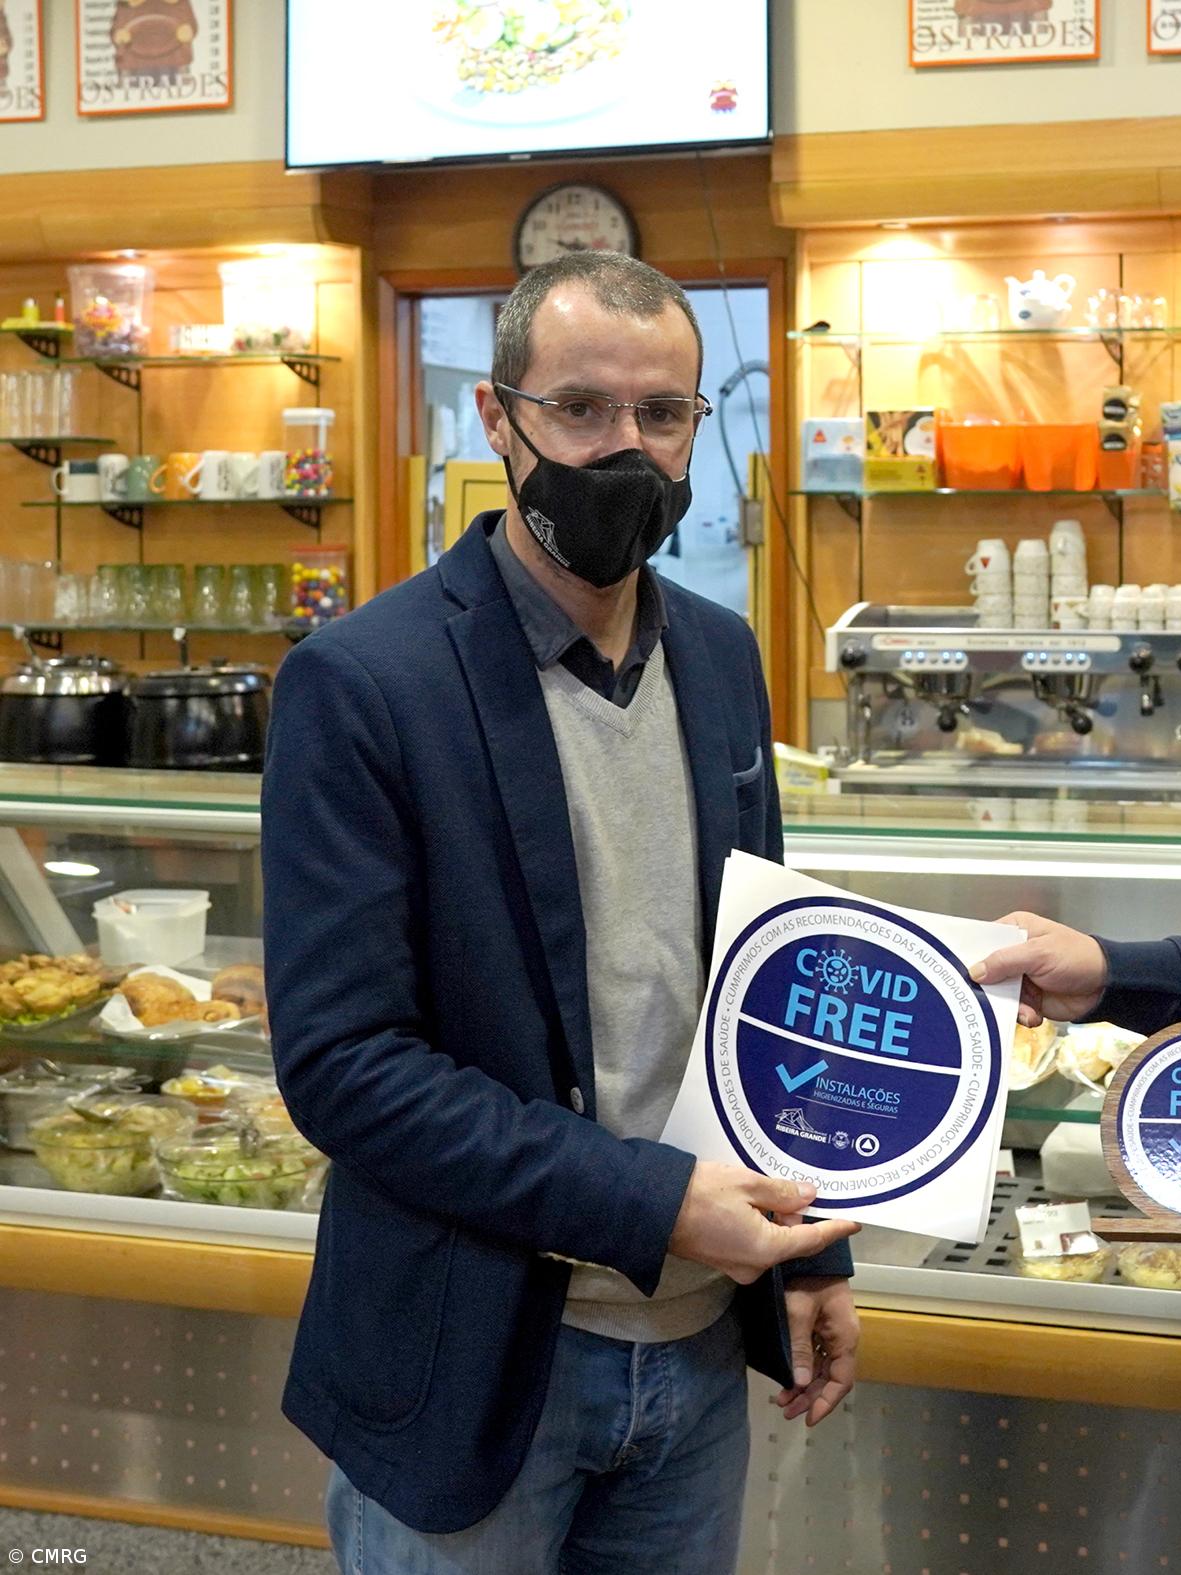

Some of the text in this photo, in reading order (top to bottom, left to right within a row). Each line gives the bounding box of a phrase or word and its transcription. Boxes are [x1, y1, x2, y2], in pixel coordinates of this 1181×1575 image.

[760, 926, 782, 946] COM
[783, 919, 795, 934] AS
[796, 914, 892, 940] RECOMENDAÇÕES
[892, 933, 916, 952] DAS
[725, 942, 762, 1005] CUMPRIMOS
[914, 949, 973, 1013] AUTORIDADES
[784, 982, 914, 1056] FREE
[965, 1011, 979, 1030] DE
[717, 1015, 731, 1056] SAÚDE
[969, 1031, 985, 1070] SAÚDE
[720, 1059, 731, 1077] DE
[813, 1090, 860, 1108] HIGIENIZADAS
[867, 1102, 899, 1114] SEGURAS
[815, 1076, 901, 1105] INSTALAÇÕES
[725, 1082, 769, 1158] AUTORIDADES
[940, 1080, 980, 1146] CUMPRIMOS
[775, 1124, 800, 1137] RIBEIRA
[799, 1130, 827, 1144] GRANDE
[767, 1155, 791, 1177] DAS
[916, 1143, 943, 1166] COM
[900, 1161, 916, 1176] AS
